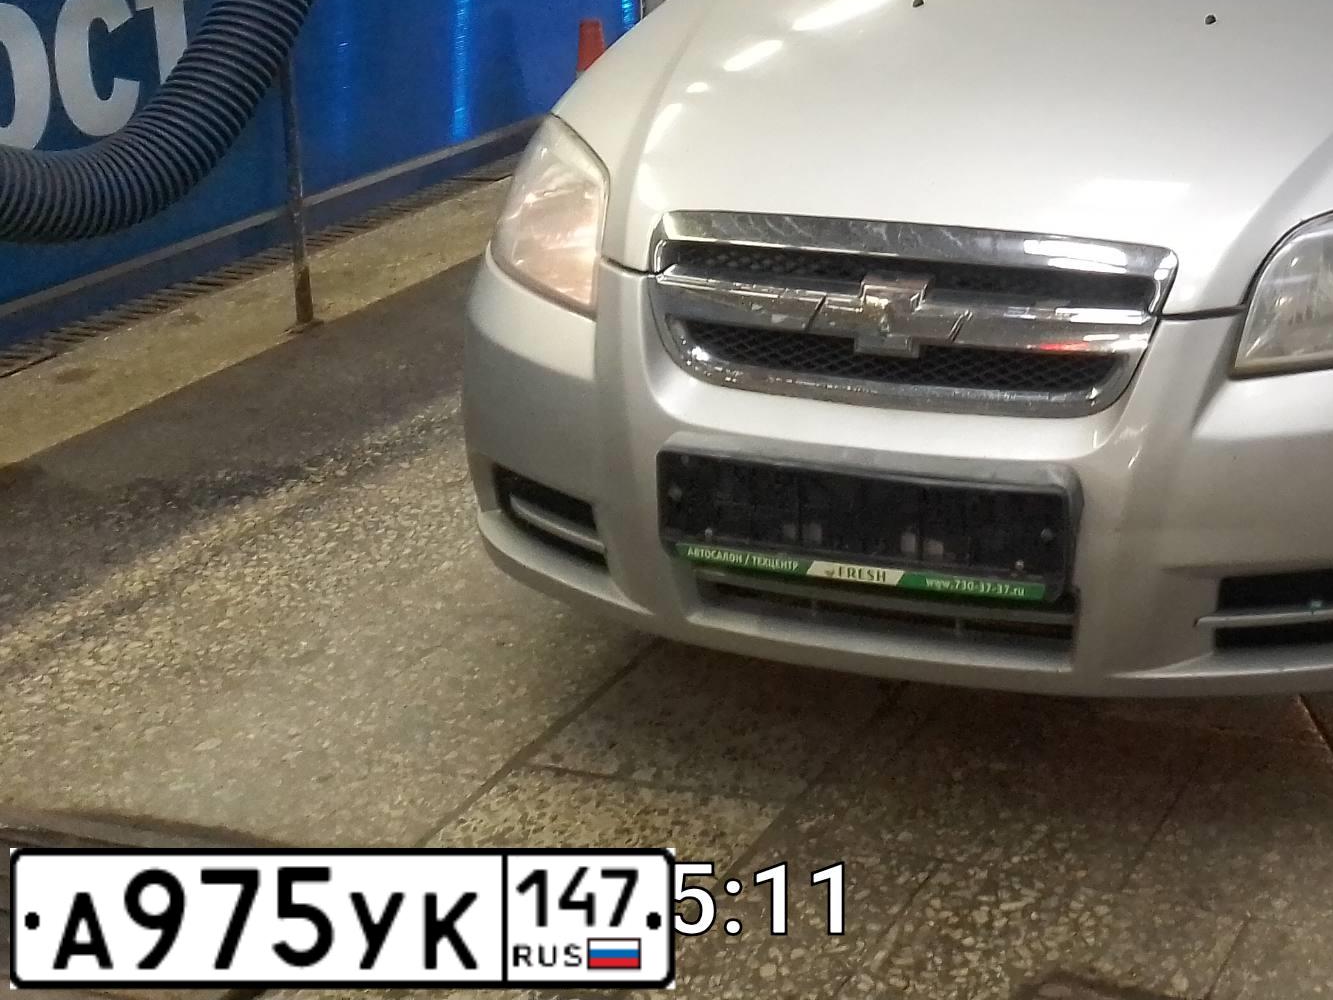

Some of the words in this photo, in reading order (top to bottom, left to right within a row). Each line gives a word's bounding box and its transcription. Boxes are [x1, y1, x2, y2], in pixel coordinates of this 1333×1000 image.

[688, 547, 743, 564] АВТОСАЛОН
[752, 556, 798, 571] ТЕХЦЕНТР
[838, 565, 887, 583] FRESH
